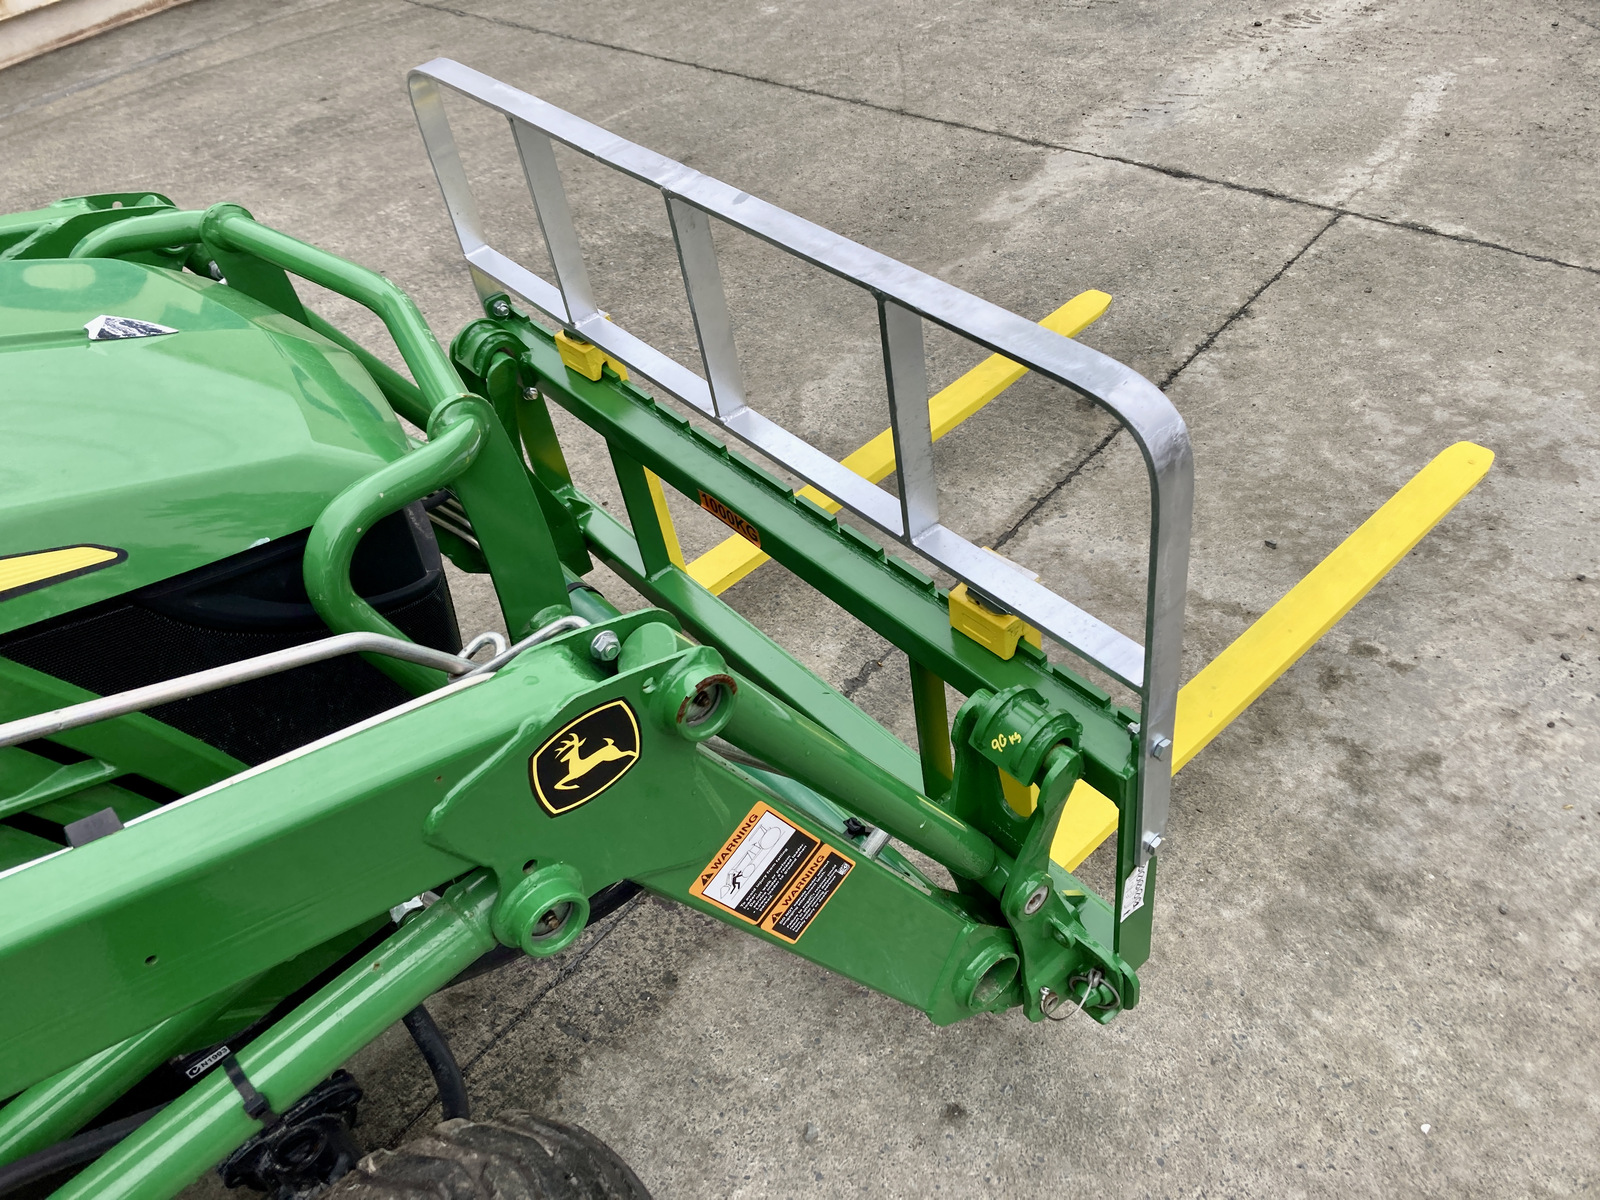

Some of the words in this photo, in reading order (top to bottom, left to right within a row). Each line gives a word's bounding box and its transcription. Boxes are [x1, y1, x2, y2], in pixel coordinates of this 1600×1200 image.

[702, 493, 758, 542] 1000KG
[991, 733, 1007, 752] 90
[711, 814, 758, 870] WARNING
[781, 855, 825, 906] WARNING
